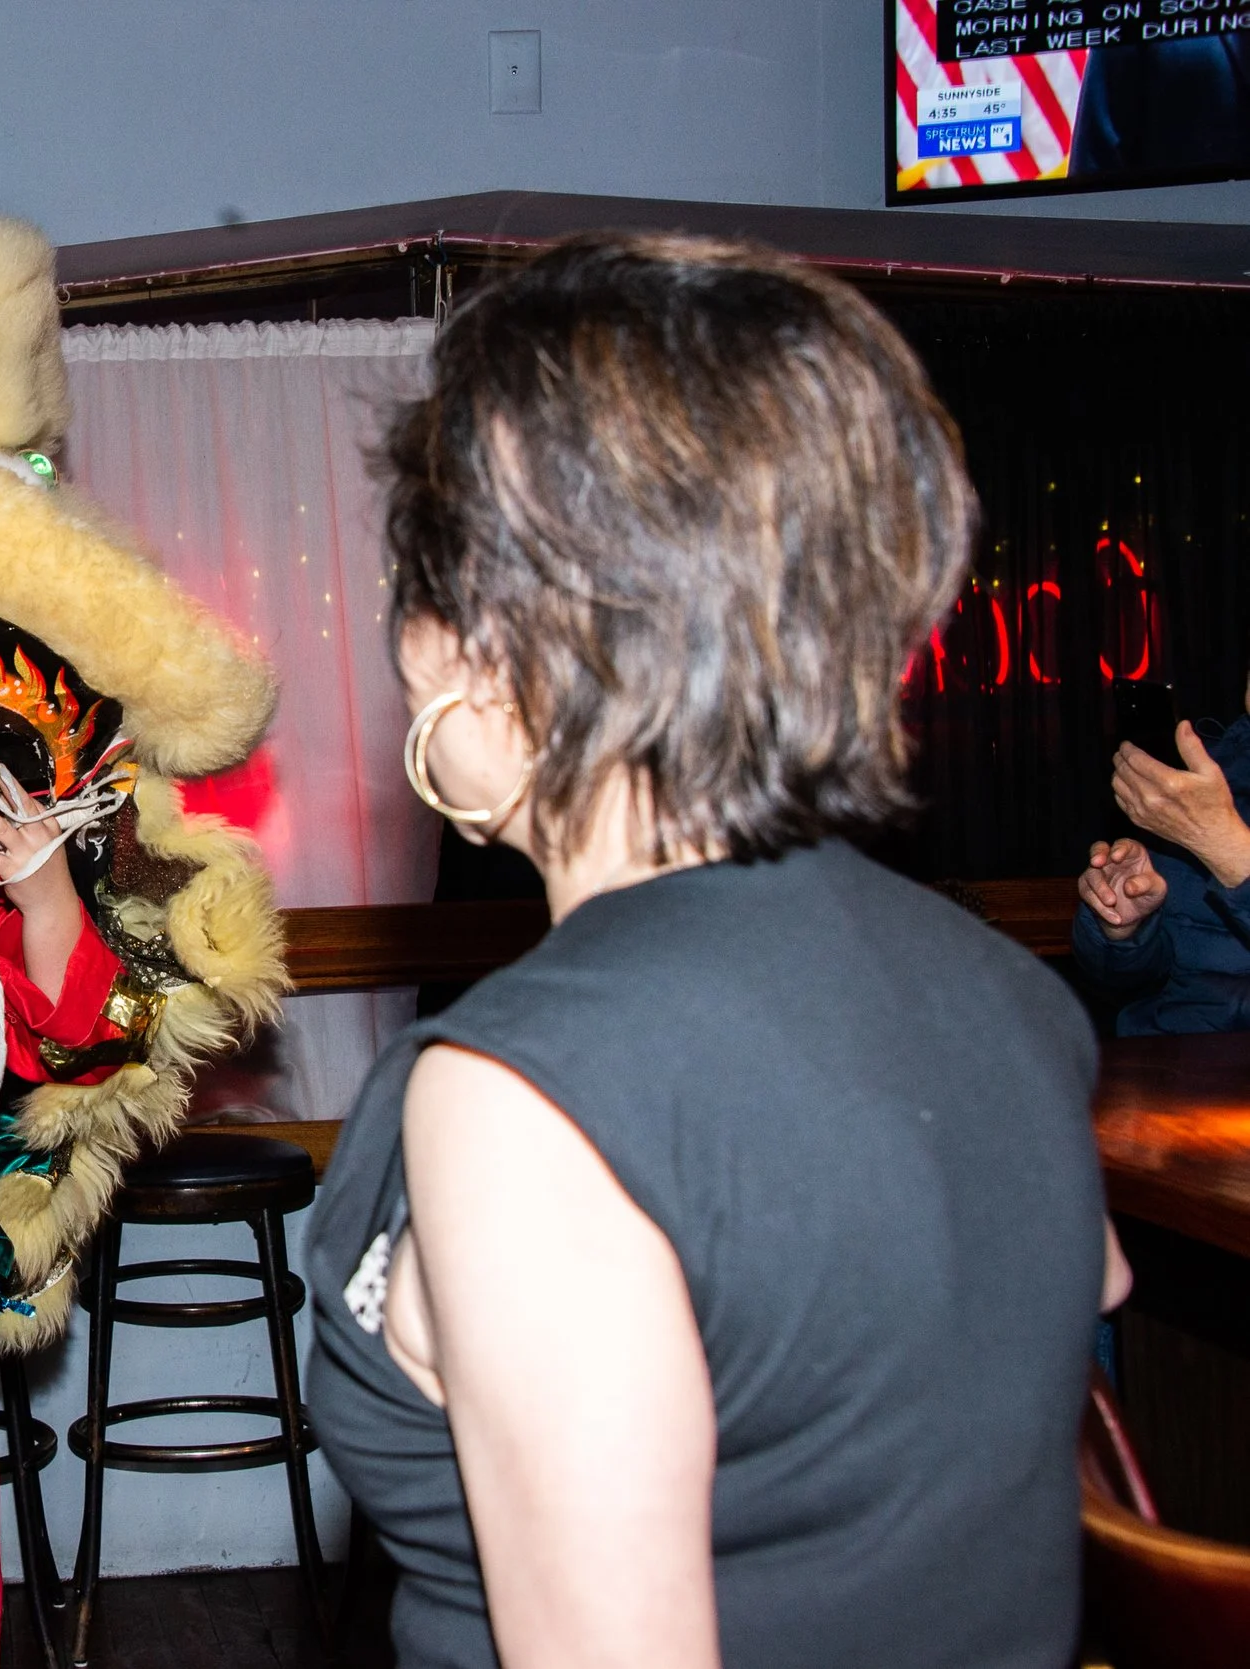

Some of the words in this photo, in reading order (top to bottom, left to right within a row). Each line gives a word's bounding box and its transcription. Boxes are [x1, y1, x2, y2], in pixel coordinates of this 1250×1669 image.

[956, 8, 1083, 37] MORNING
[1103, 1, 1140, 21] ON
[956, 35, 1027, 58] LAST
[1047, 25, 1121, 49] WEEK
[938, 88, 1001, 101] SUNNYSIDE
[928, 108, 957, 119] 4:35
[925, 126, 986, 140] SPECTRUM
[1004, 134, 1010, 144] 1
[939, 137, 986, 152] NEWS
